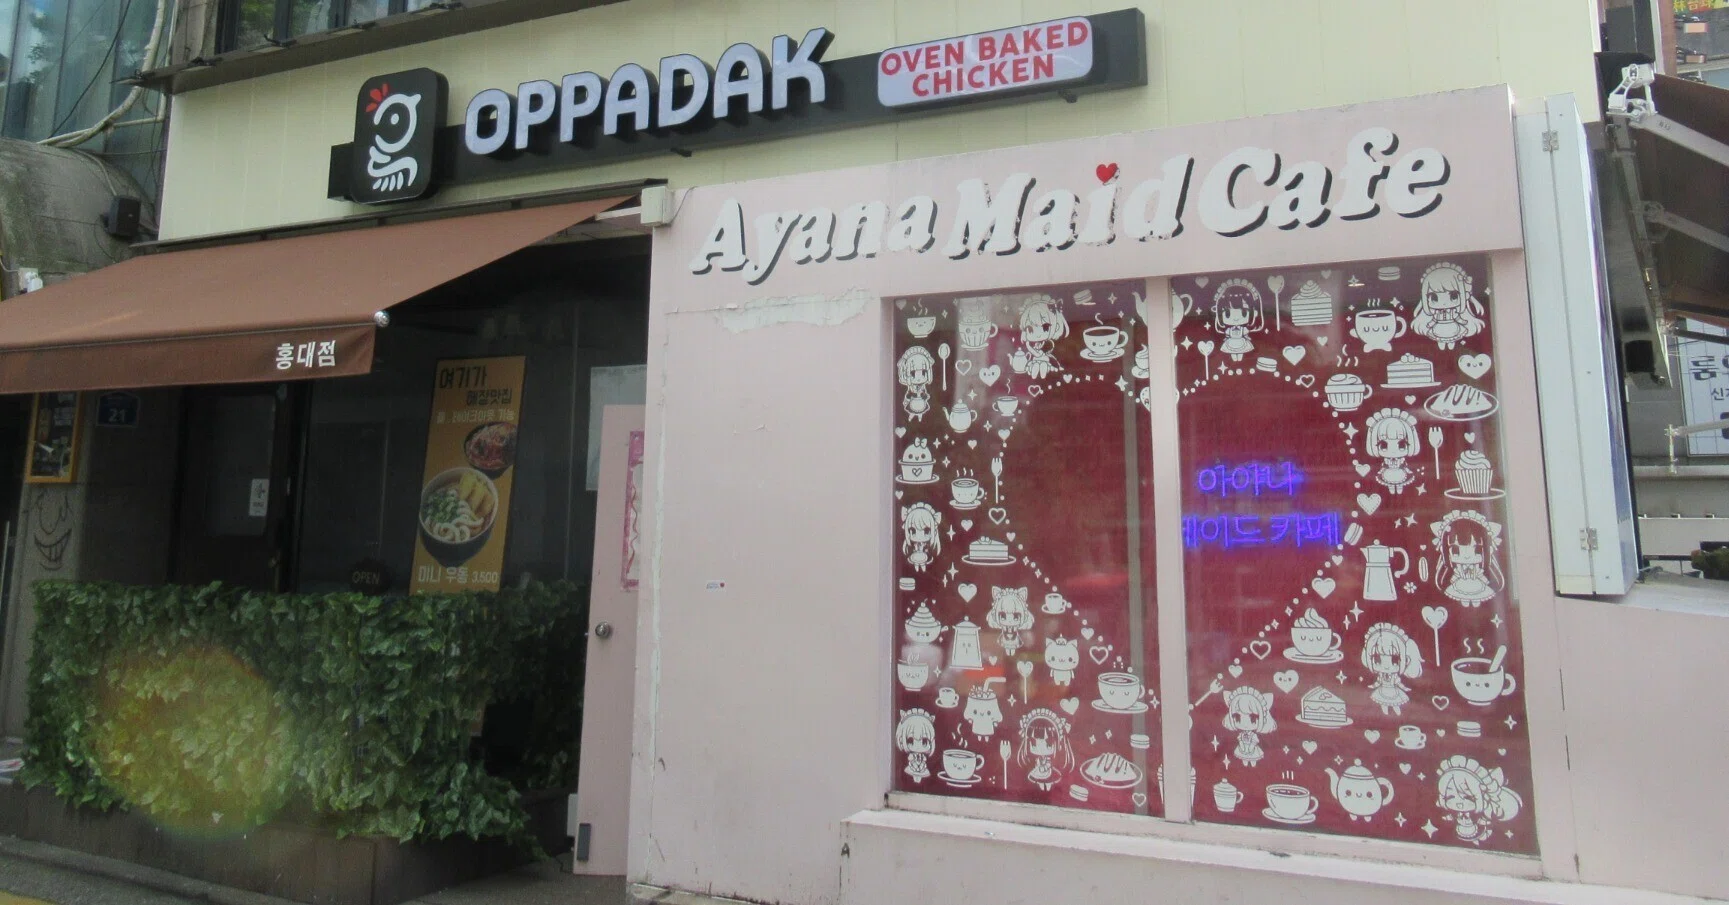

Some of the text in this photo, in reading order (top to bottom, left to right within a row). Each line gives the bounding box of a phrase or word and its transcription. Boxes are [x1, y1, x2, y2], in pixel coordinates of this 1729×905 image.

[881, 21, 1089, 76] OVEN BAKED
[465, 27, 833, 155] OPPADAK
[912, 53, 1055, 97] CHICKEN
[689, 127, 1451, 286] Ayana Maid Cafe
[275, 340, 336, 370] 홍대점
[439, 365, 488, 389] 여기가
[108, 408, 125, 423] 21
[1198, 461, 1300, 497] 아야나
[1269, 511, 1340, 548] 카페
[351, 571, 380, 585] OPEN
[418, 565, 442, 583] 미니
[446, 566, 469, 585] 우동
